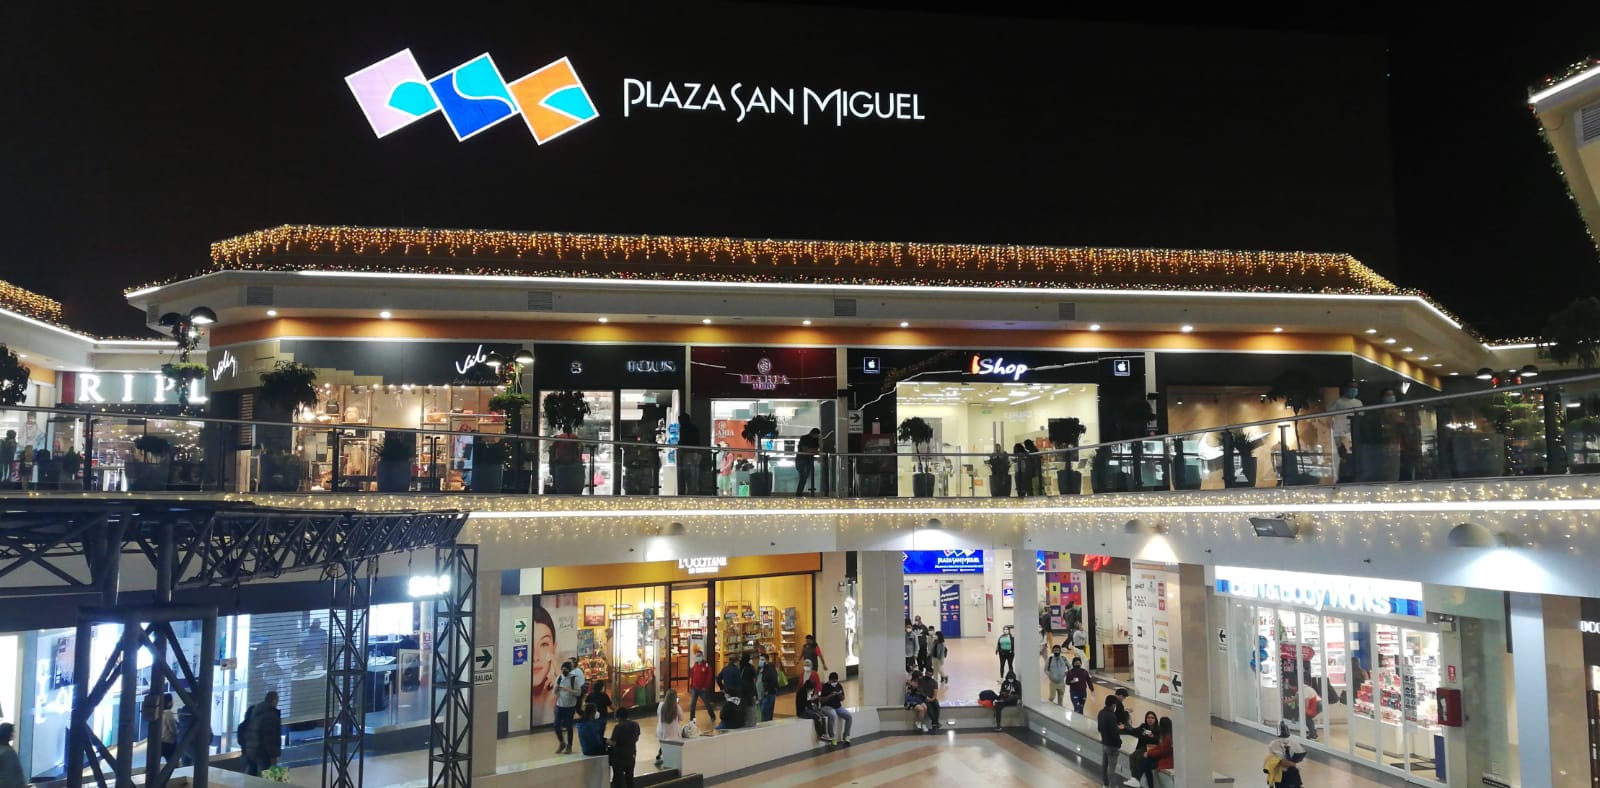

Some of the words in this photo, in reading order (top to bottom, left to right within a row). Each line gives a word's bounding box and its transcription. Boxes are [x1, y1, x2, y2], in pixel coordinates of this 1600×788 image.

[623, 77, 727, 118] PLAZA
[730, 82, 794, 123] SAN
[803, 86, 926, 127] MIGUEL
[971, 353, 1028, 381] iShop
